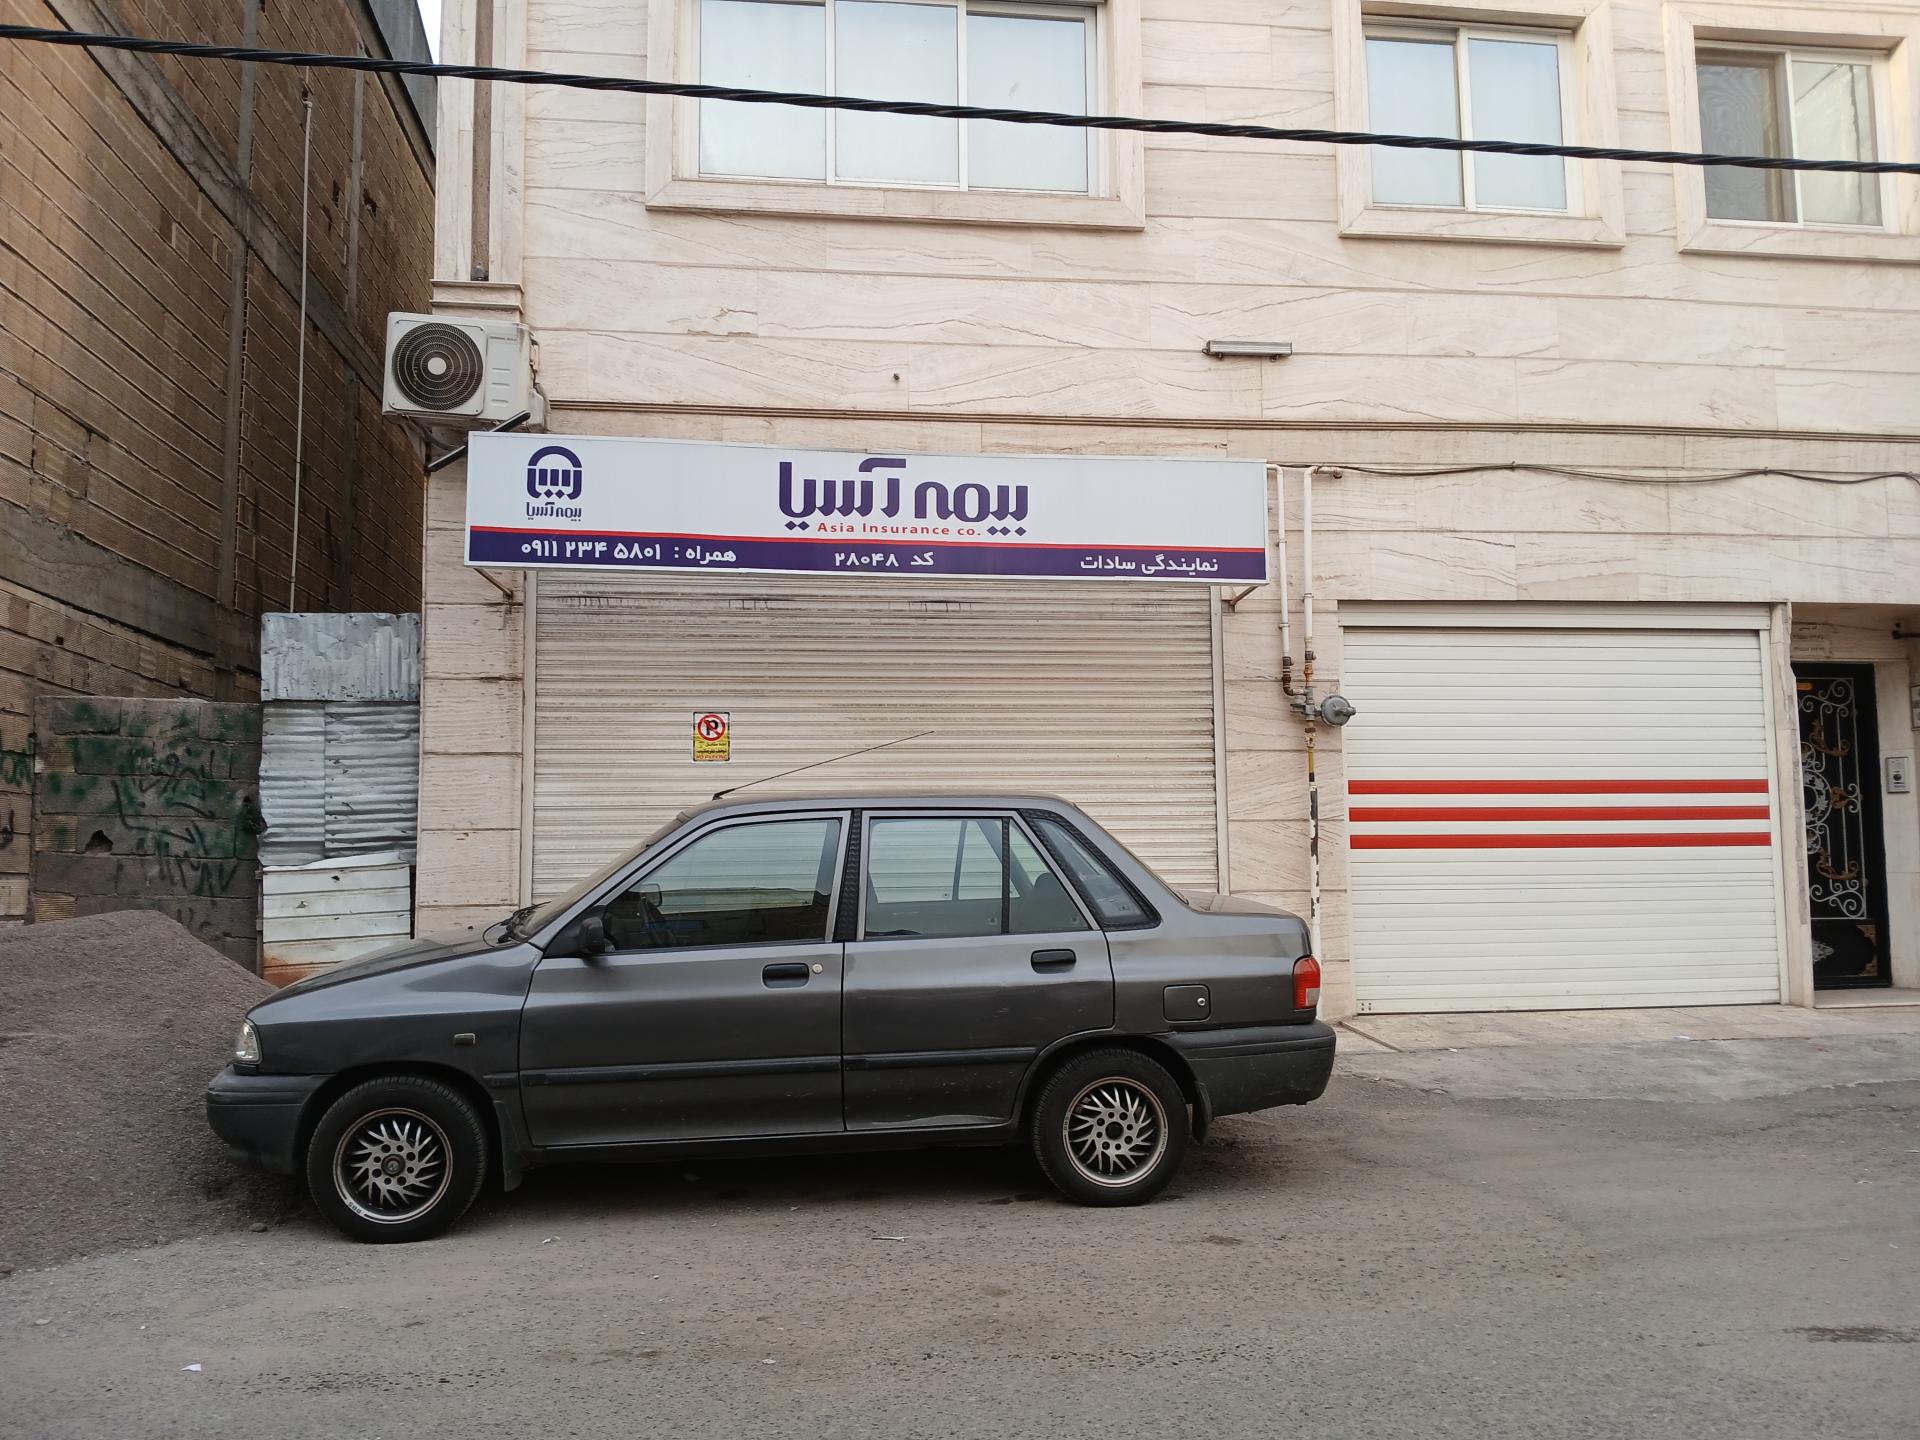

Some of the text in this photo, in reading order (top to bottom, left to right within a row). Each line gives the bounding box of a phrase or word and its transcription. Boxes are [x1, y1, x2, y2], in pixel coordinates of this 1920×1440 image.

[778, 457, 1029, 537] بیمه آسیا
[526, 501, 582, 522] بیمه آسیا
[817, 522, 981, 537] Asia Insurance co.
[521, 539, 558, 557] ۰۹۱۱
[565, 541, 608, 558] ۲۳۴
[613, 542, 661, 560] ۵۸۰۱
[834, 551, 934, 567] کد ۲۸۰۴۸
[1080, 553, 1219, 576] نمایندگی سادات
